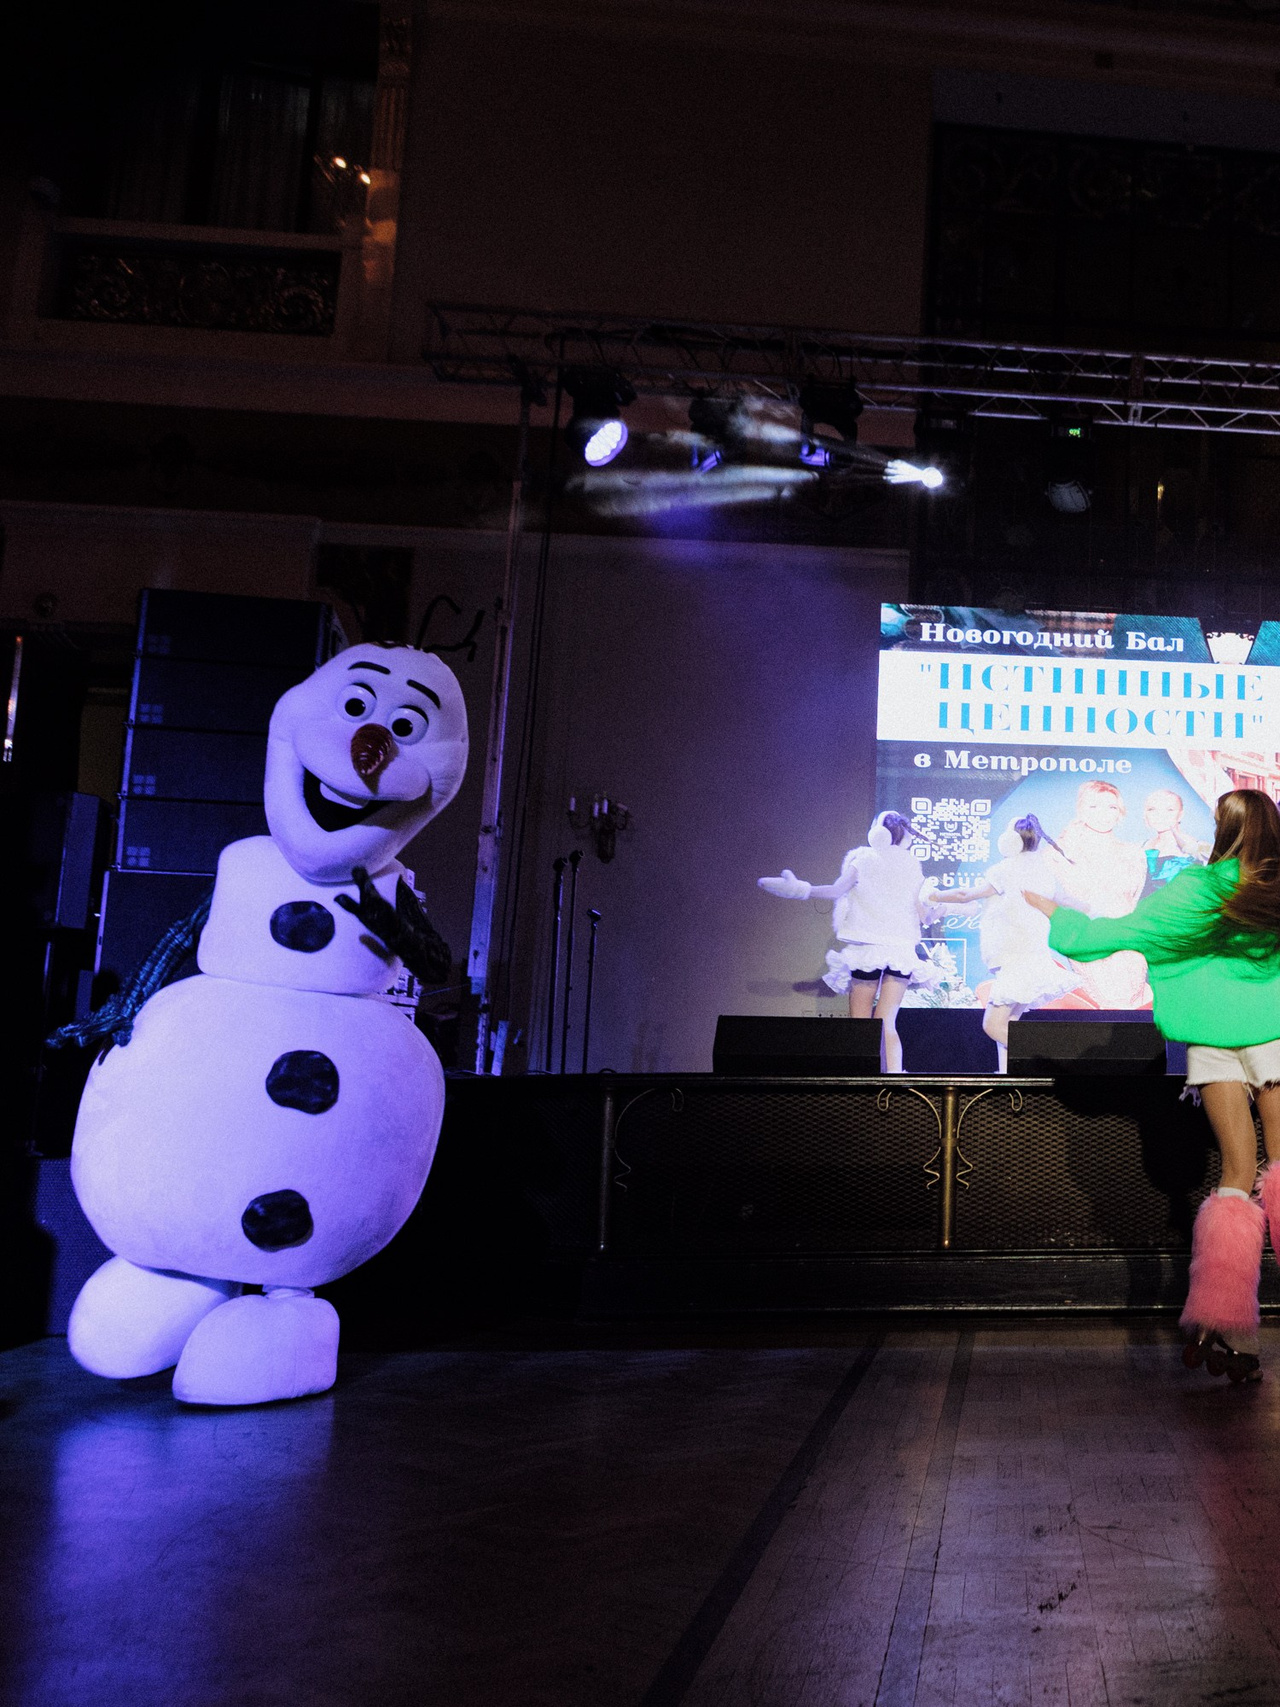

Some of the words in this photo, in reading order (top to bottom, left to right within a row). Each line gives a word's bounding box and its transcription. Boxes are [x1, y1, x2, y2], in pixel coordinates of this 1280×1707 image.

[919, 622, 1115, 650] Новогодний
[1125, 630, 1185, 653] Бал
[920, 662, 1264, 702] "ИСТИННЫЕ
[938, 701, 1264, 739] ЦЕННОСТИ"
[913, 751, 932, 769] в
[944, 749, 1133, 777] Метрополе
